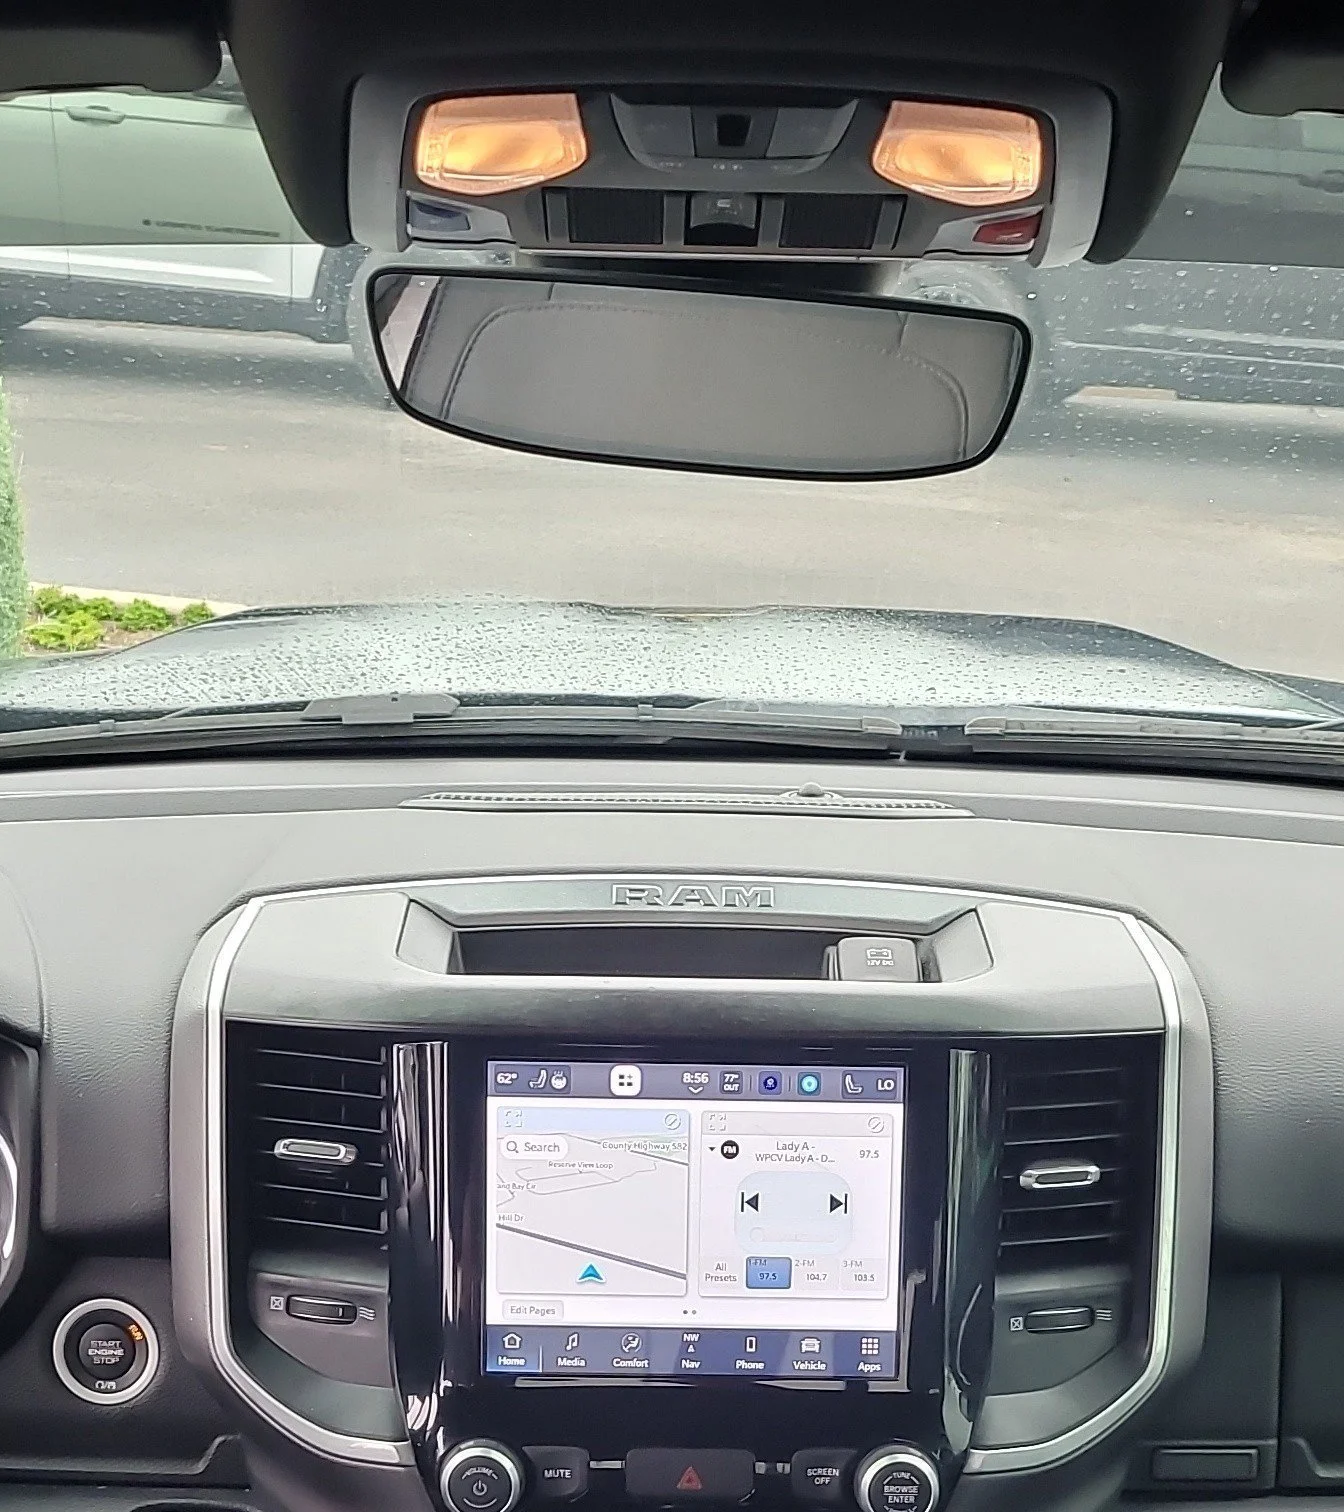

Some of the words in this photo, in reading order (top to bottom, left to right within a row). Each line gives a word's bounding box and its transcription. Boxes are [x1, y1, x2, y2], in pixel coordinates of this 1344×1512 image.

[612, 884, 775, 908] RAM
[682, 1072, 709, 1084] 8:56
[723, 1083, 740, 1092] OUT
[877, 1078, 895, 1091] LO
[524, 1141, 560, 1153] Search
[602, 1141, 632, 1152] County
[634, 1141, 671, 1152] Highway
[723, 1145, 737, 1154] FM
[776, 1141, 799, 1153] Lady
[801, 1141, 810, 1151] A
[755, 1153, 783, 1162] WPCV
[785, 1153, 805, 1164] Lady
[859, 1149, 880, 1159] 97.5
[596, 1161, 613, 1170] Loop
[499, 1214, 512, 1222] Hill
[514, 1214, 524, 1222] Dr
[715, 1262, 727, 1271] All
[795, 1259, 815, 1267] 2-FM
[843, 1260, 863, 1268] 3-FM
[705, 1273, 737, 1282] Presets
[759, 1272, 777, 1281] 97.5
[806, 1273, 827, 1281] 104.7
[510, 1305, 527, 1315] Edit
[529, 1306, 556, 1317] Pages
[682, 1333, 700, 1342] NW
[90, 1340, 122, 1348] START
[88, 1348, 125, 1356] ENGINE
[93, 1357, 120, 1365] STOP
[497, 1356, 526, 1366] Home
[557, 1356, 586, 1367] Media
[612, 1357, 649, 1368] Comfort
[681, 1359, 701, 1369] Nav
[735, 1360, 765, 1370] Phone
[792, 1360, 827, 1371] Vehicle
[858, 1361, 882, 1373] Apps
[544, 1469, 572, 1479] MUTE
[806, 1468, 840, 1477] SCREEN
[893, 1471, 911, 1479] TUNE
[814, 1477, 831, 1485] OFF
[884, 1485, 919, 1493] BROWSE
[888, 1495, 915, 1504] ENTER
